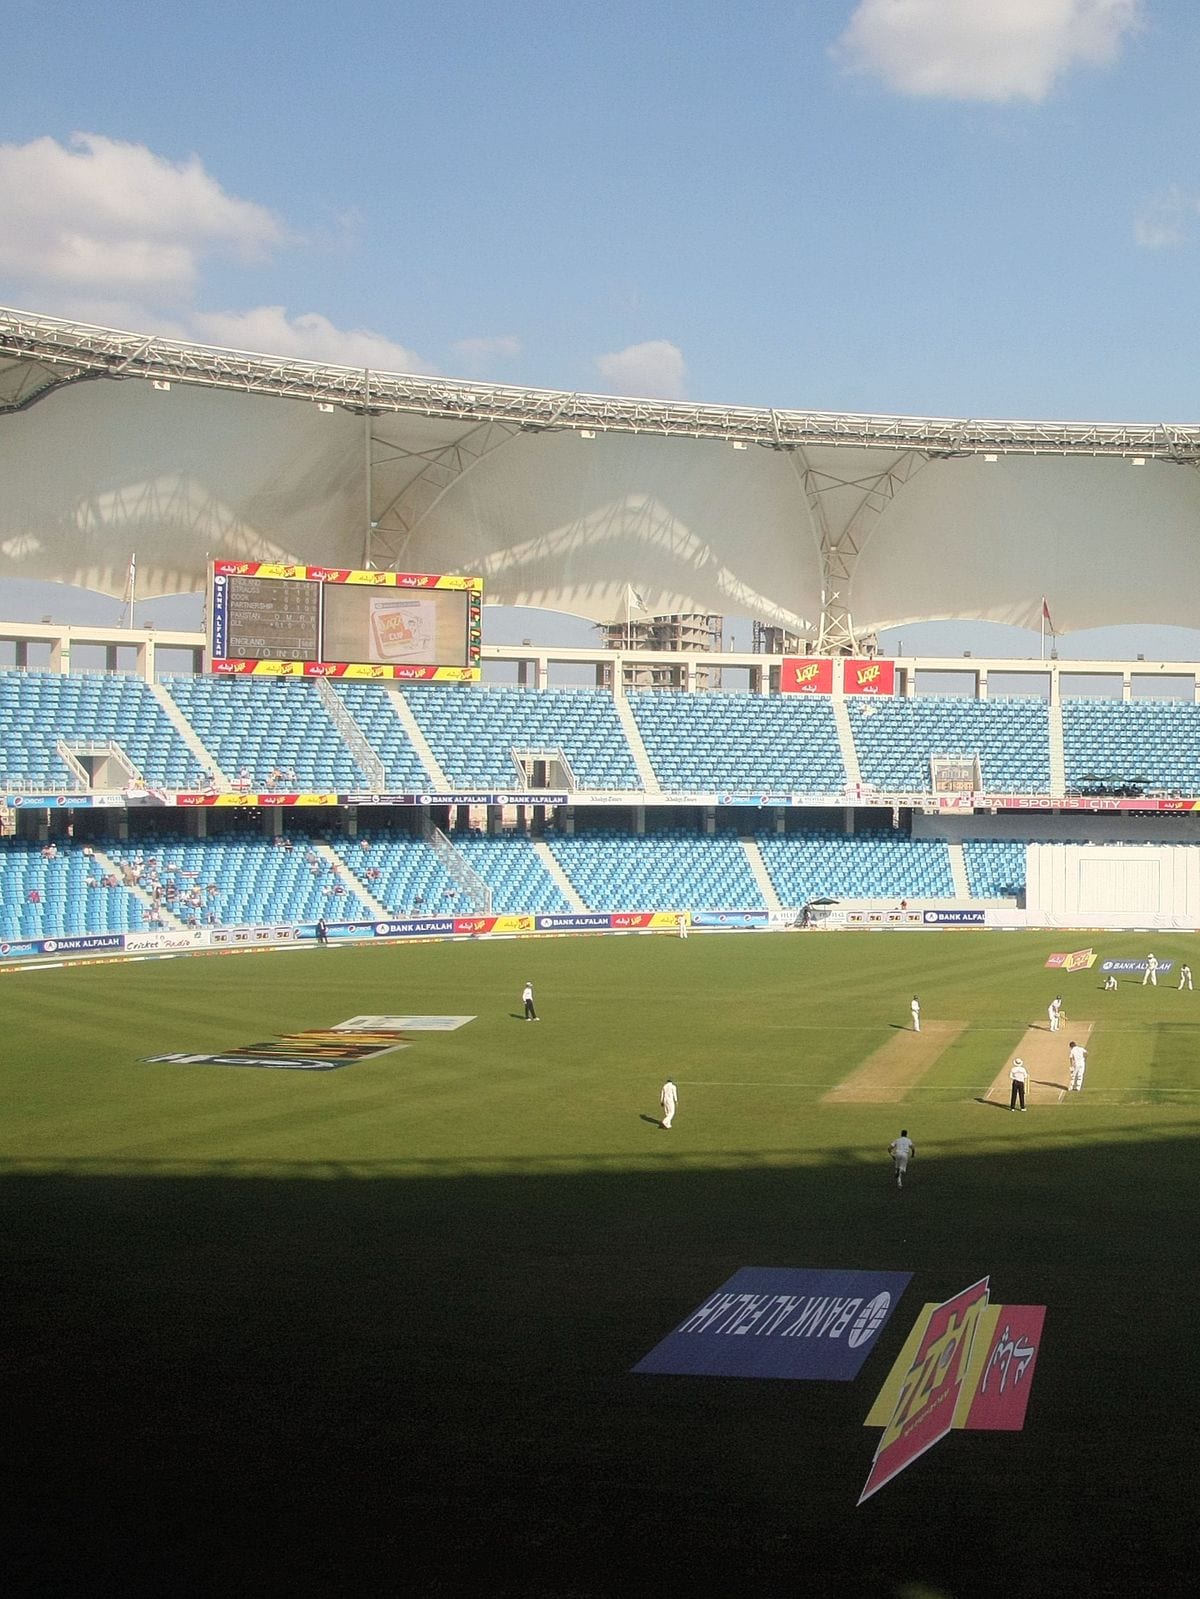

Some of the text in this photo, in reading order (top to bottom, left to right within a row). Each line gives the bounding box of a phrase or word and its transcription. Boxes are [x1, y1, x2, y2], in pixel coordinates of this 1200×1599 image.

[796, 664, 819, 684] JAZZ
[857, 665, 880, 684] JAZZ
[1019, 800, 1079, 808] SPORTS
[553, 918, 574, 926] BANK
[939, 913, 960, 921] BANK
[390, 922, 453, 932] BANK ALFALAH
[58, 938, 119, 950] BANK ALFALAH
[127, 939, 190, 950] Cricket Radio
[1113, 962, 1135, 970] BANK
[679, 1293, 864, 1338] BANK ALFALAH
[879, 1295, 987, 1453] JAZZ
